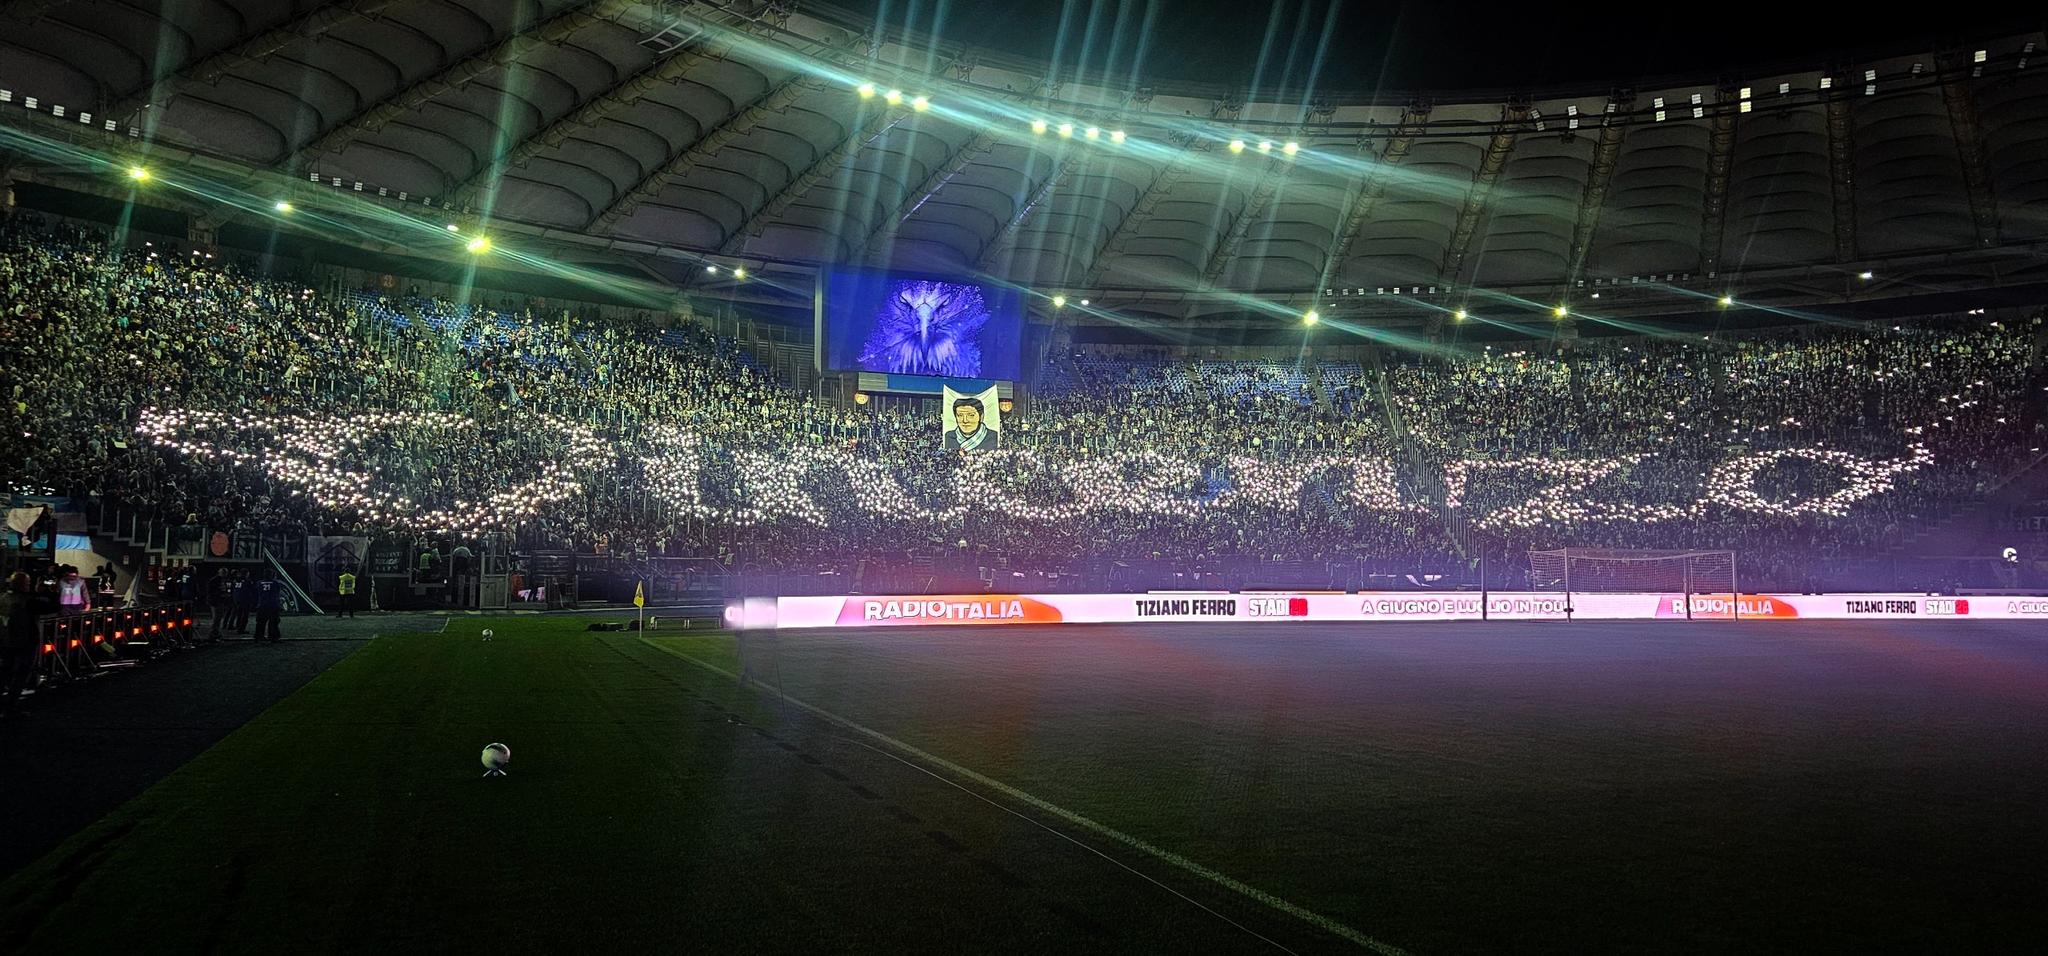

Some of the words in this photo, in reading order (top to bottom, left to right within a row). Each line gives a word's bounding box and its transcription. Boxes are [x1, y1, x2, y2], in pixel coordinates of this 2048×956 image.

[1135, 600, 1190, 616] TIZIANO
[1192, 599, 1236, 616] FERRO
[1361, 600, 1375, 615] A
[1376, 600, 1442, 615] GIUGNO
[1443, 600, 1455, 614] E
[1514, 600, 1531, 614] IN
[1846, 600, 1883, 614] TIZIANO
[1885, 600, 1917, 614] FERRO
[2007, 601, 2018, 614] A
